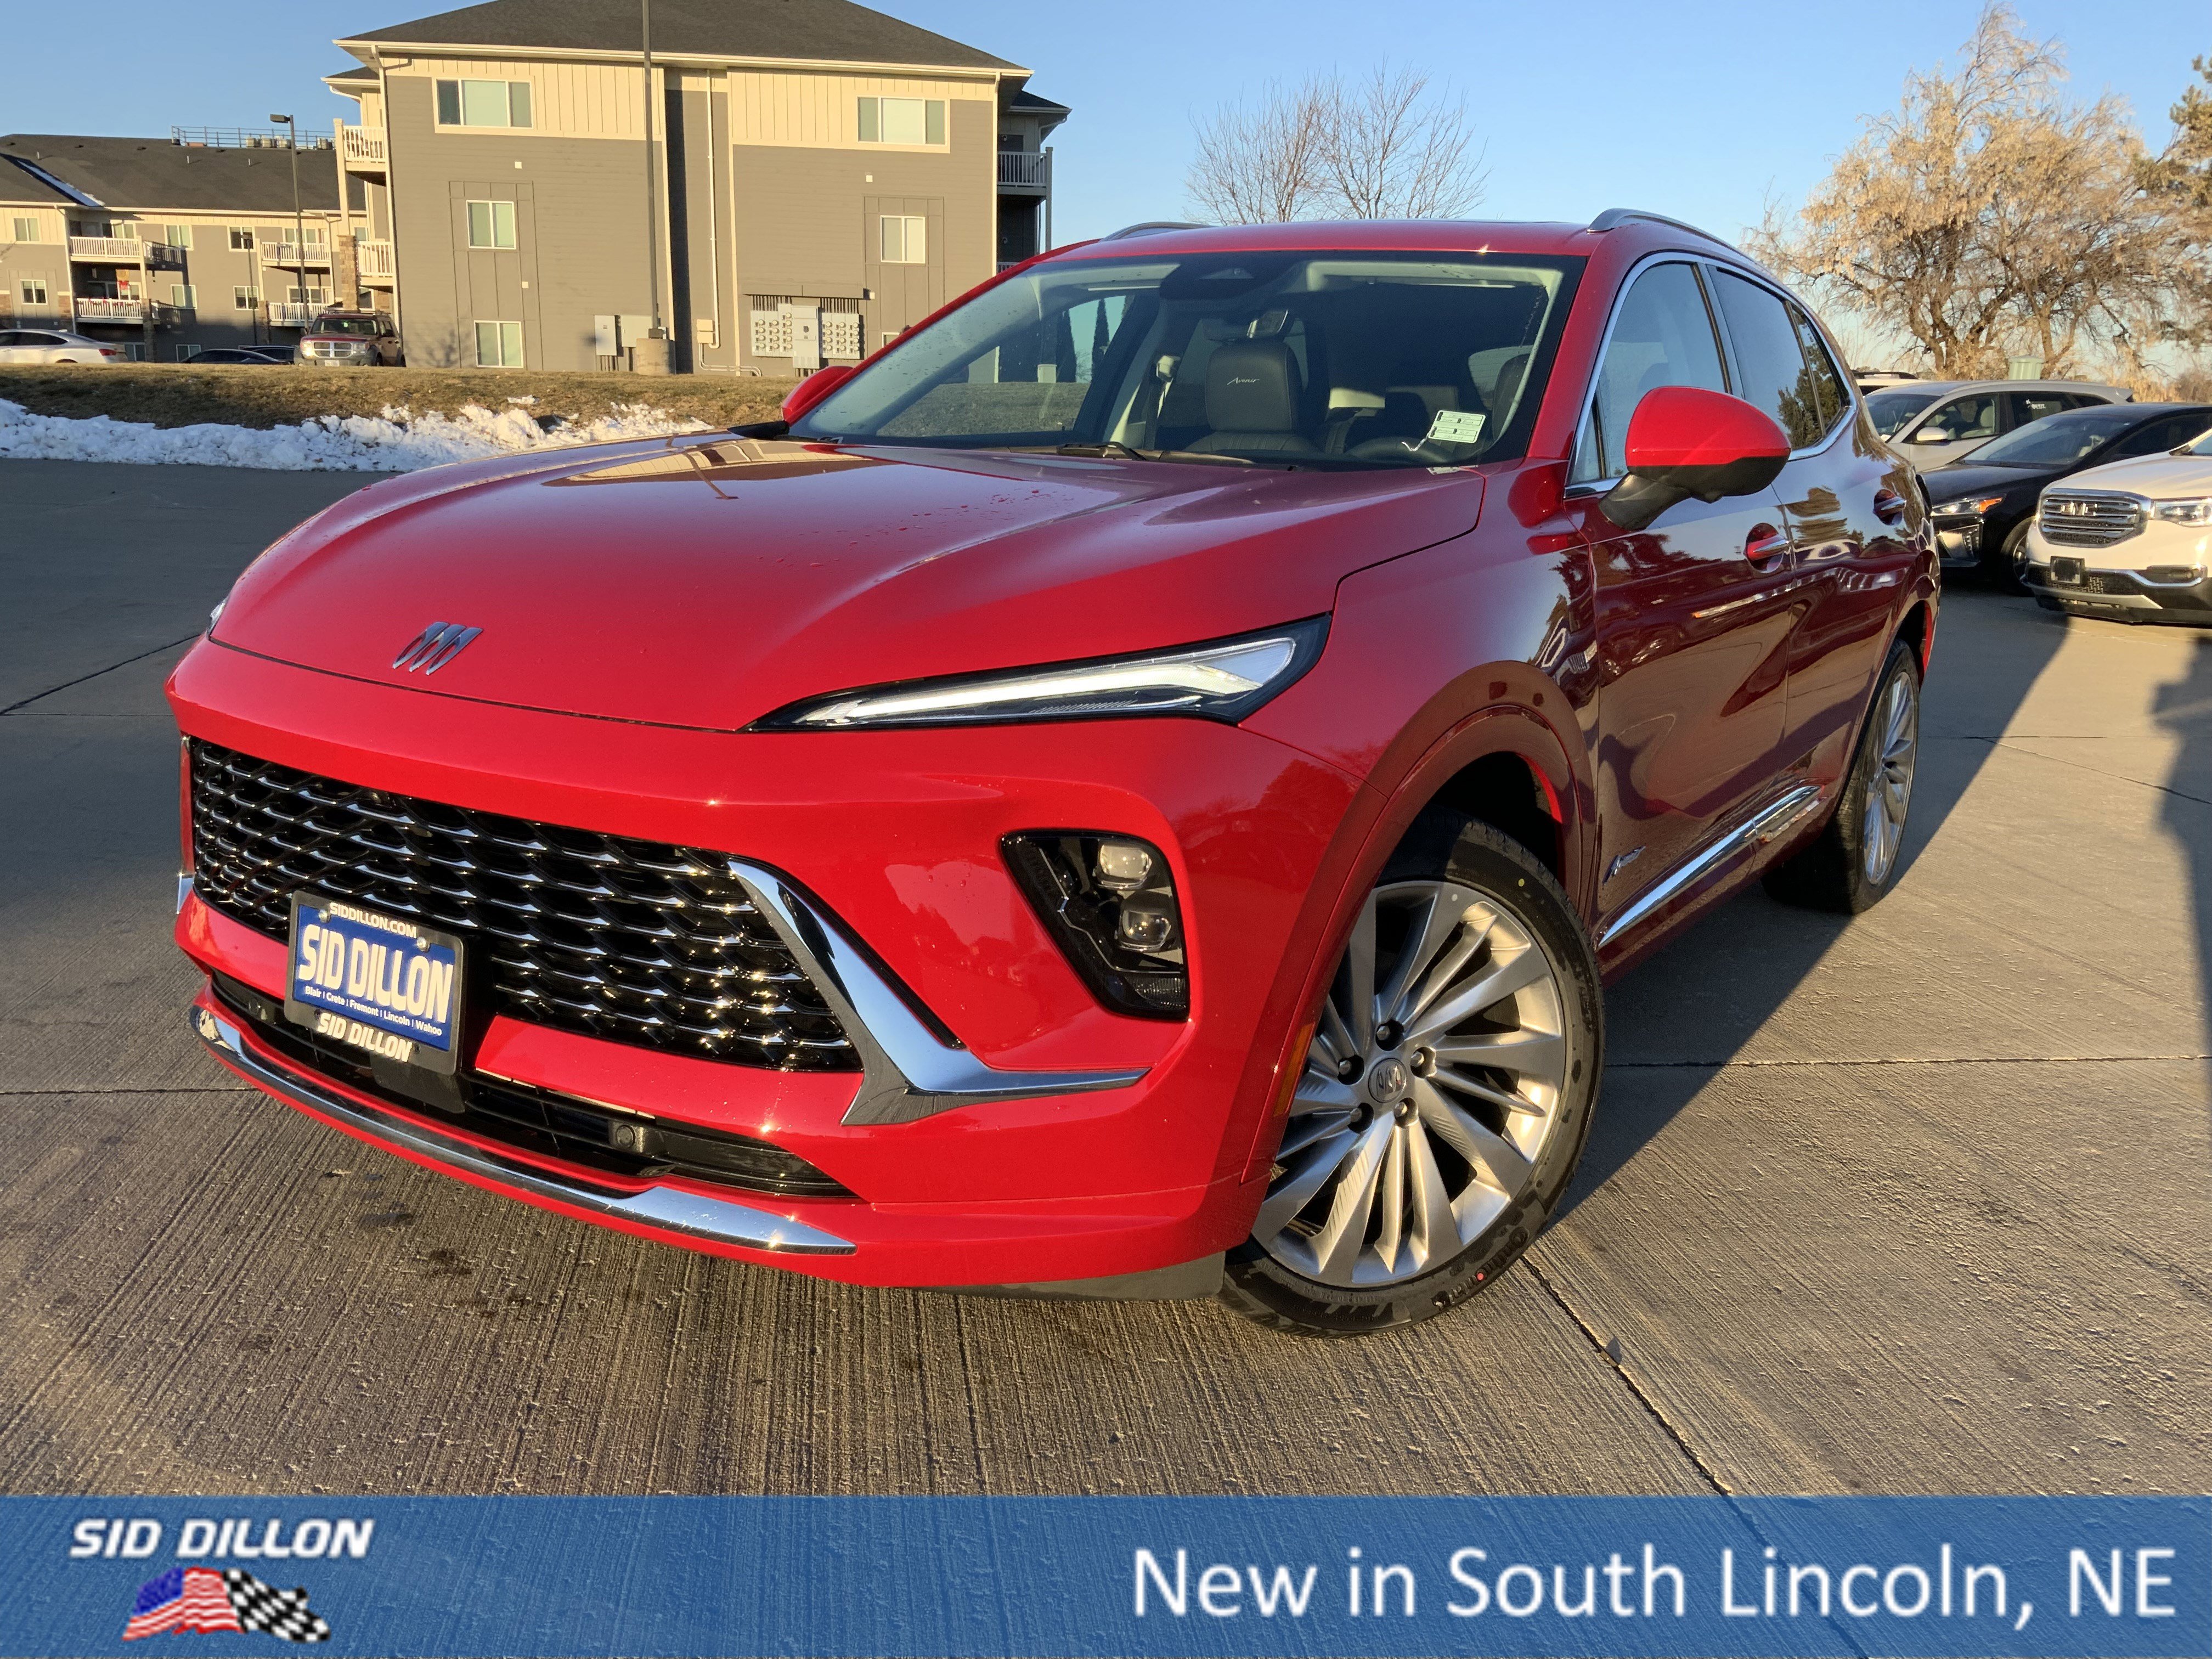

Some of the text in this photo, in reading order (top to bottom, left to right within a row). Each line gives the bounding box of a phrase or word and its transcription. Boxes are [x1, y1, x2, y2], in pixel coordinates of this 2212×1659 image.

[2060, 501, 2098, 517] GMC
[329, 902, 417, 939] SIDDILLON.COM
[298, 924, 454, 1024] SID DILLON
[305, 985, 442, 1036] Blair Crete Fremont Lincoln Wahoo
[317, 1012, 413, 1063] SID DILLON
